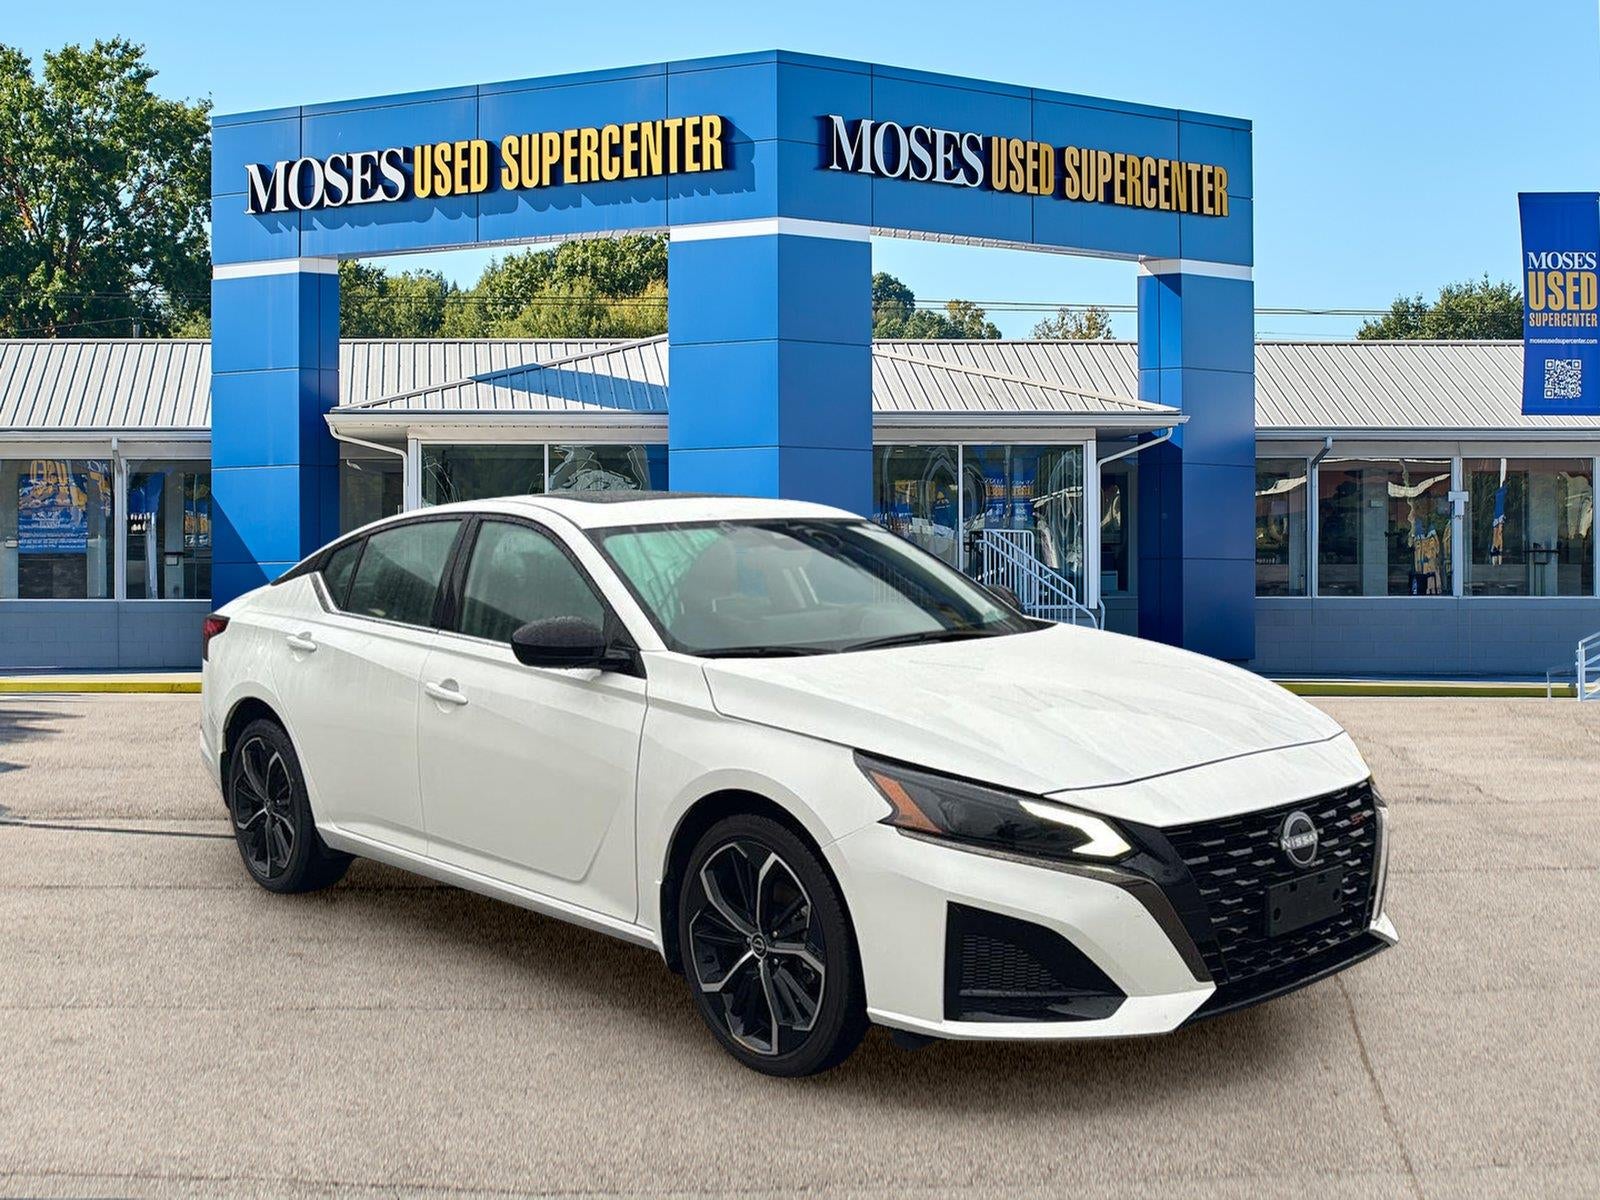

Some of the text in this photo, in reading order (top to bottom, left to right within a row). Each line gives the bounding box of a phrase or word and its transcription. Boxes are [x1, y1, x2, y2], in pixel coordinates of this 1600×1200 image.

[244, 114, 723, 215] MOSES USED SUPERCENTER
[828, 114, 1230, 217] MOSES USED SUPERCENTER
[1527, 251, 1597, 271] MOSES
[1527, 271, 1598, 311] USED
[1529, 312, 1598, 327] SUPERCENTER
[1529, 337, 1598, 345] mosesusedsupercenter.com
